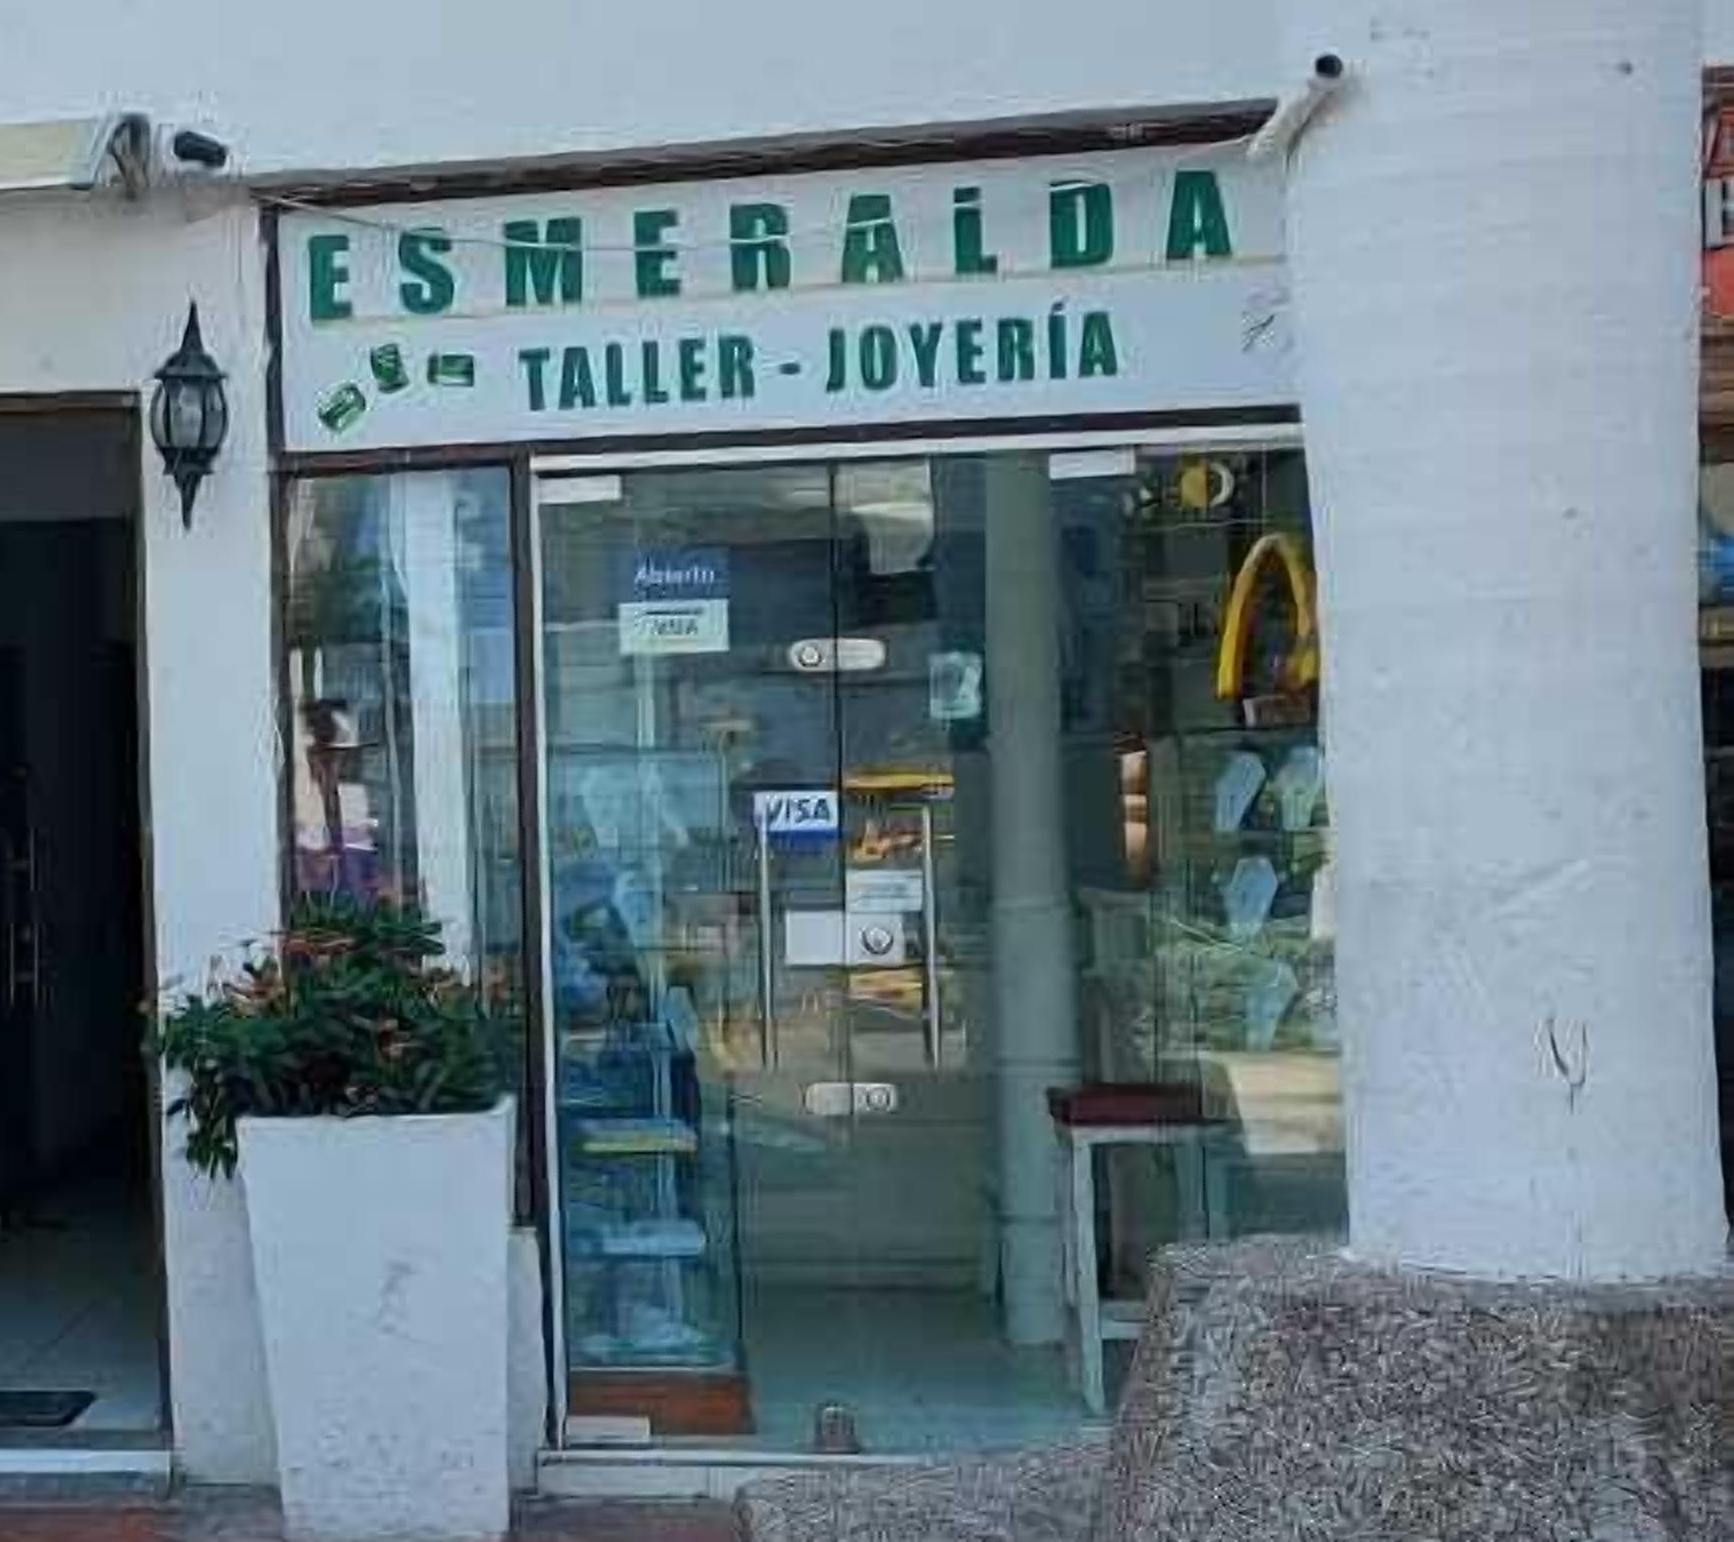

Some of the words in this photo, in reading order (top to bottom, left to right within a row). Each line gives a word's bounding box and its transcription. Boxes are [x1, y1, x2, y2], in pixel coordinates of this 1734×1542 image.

[308, 169, 1234, 323] ESMERALDA
[519, 335, 756, 414] TALLER
[824, 300, 1119, 394] JOYERÍA
[765, 797, 831, 823] VISA
